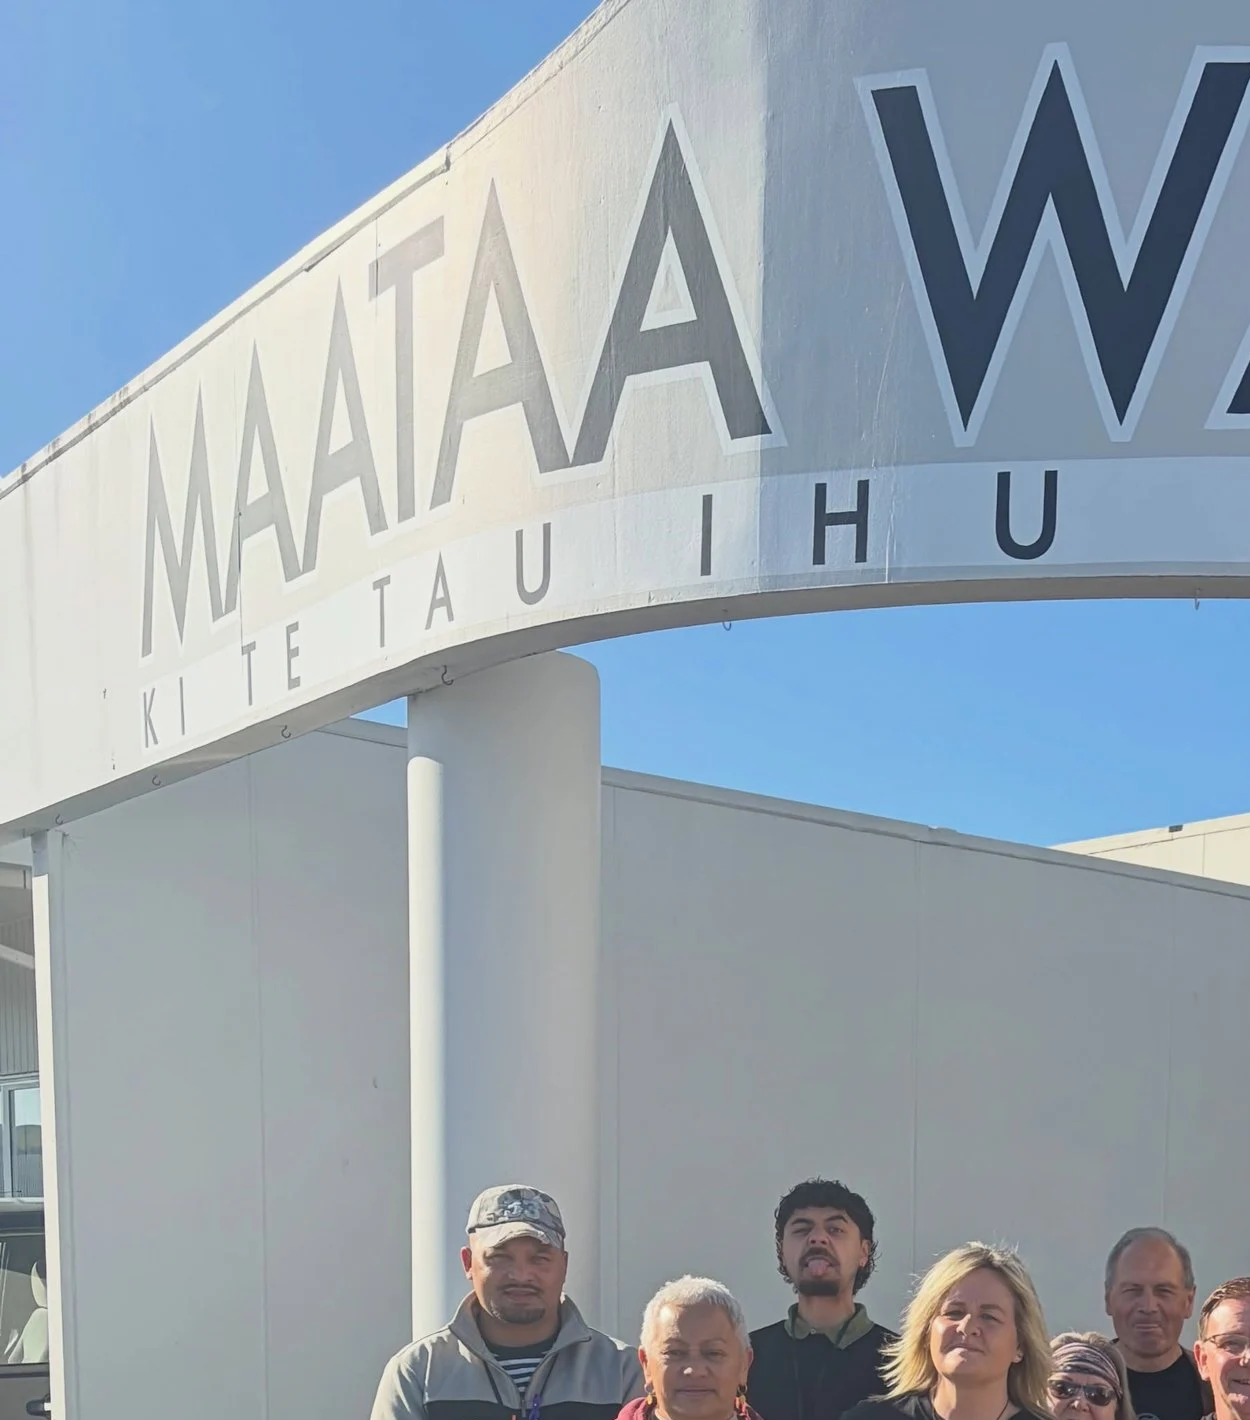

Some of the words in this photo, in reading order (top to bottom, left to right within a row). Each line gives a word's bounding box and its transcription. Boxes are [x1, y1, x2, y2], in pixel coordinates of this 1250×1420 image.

[141, 118, 773, 657] MAATAA
[141, 676, 185, 748] KI
[240, 620, 301, 706] TE
[372, 521, 552, 648] TAU
[700, 469, 1058, 577] IHU
